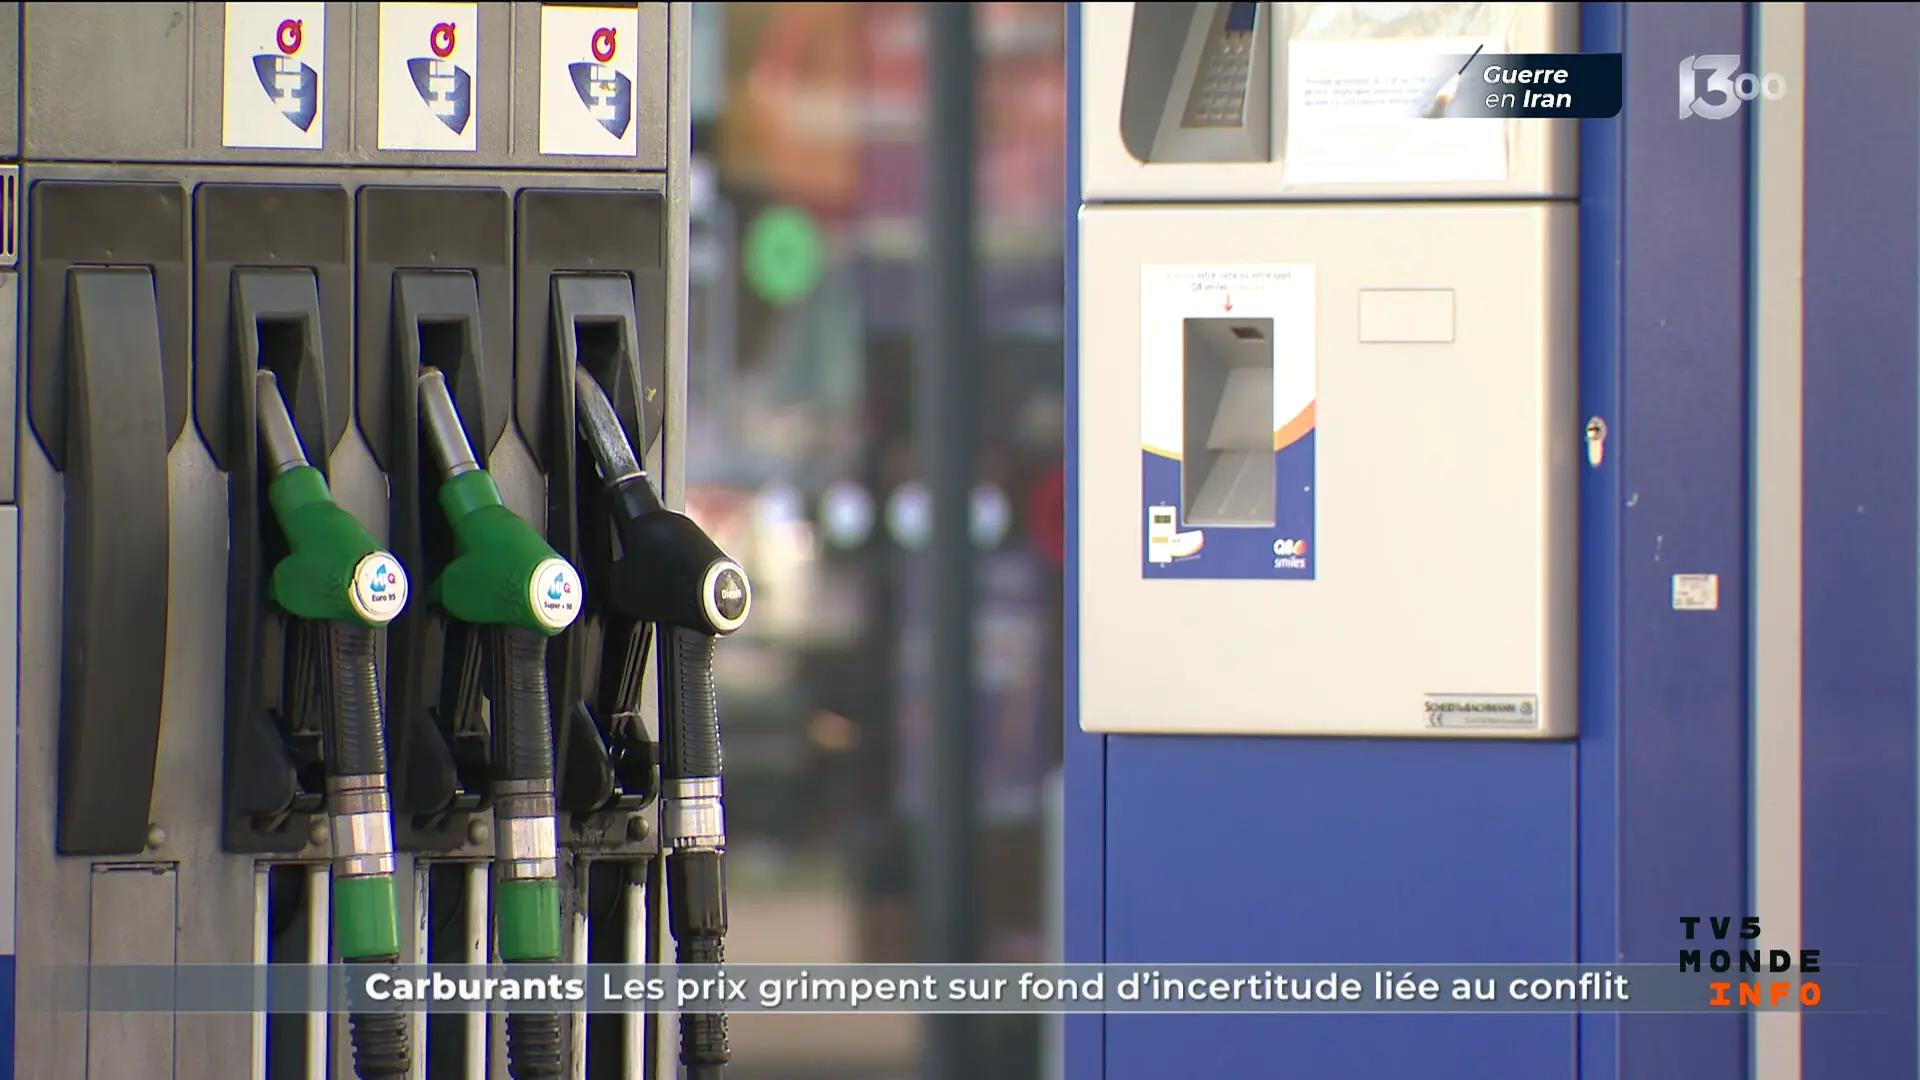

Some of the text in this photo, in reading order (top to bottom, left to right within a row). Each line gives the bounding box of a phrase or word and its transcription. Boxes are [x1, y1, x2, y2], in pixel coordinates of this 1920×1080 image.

[1273, 555, 1306, 569] smiles
[371, 593, 396, 602] Euro 95
[543, 601, 561, 610] Super
